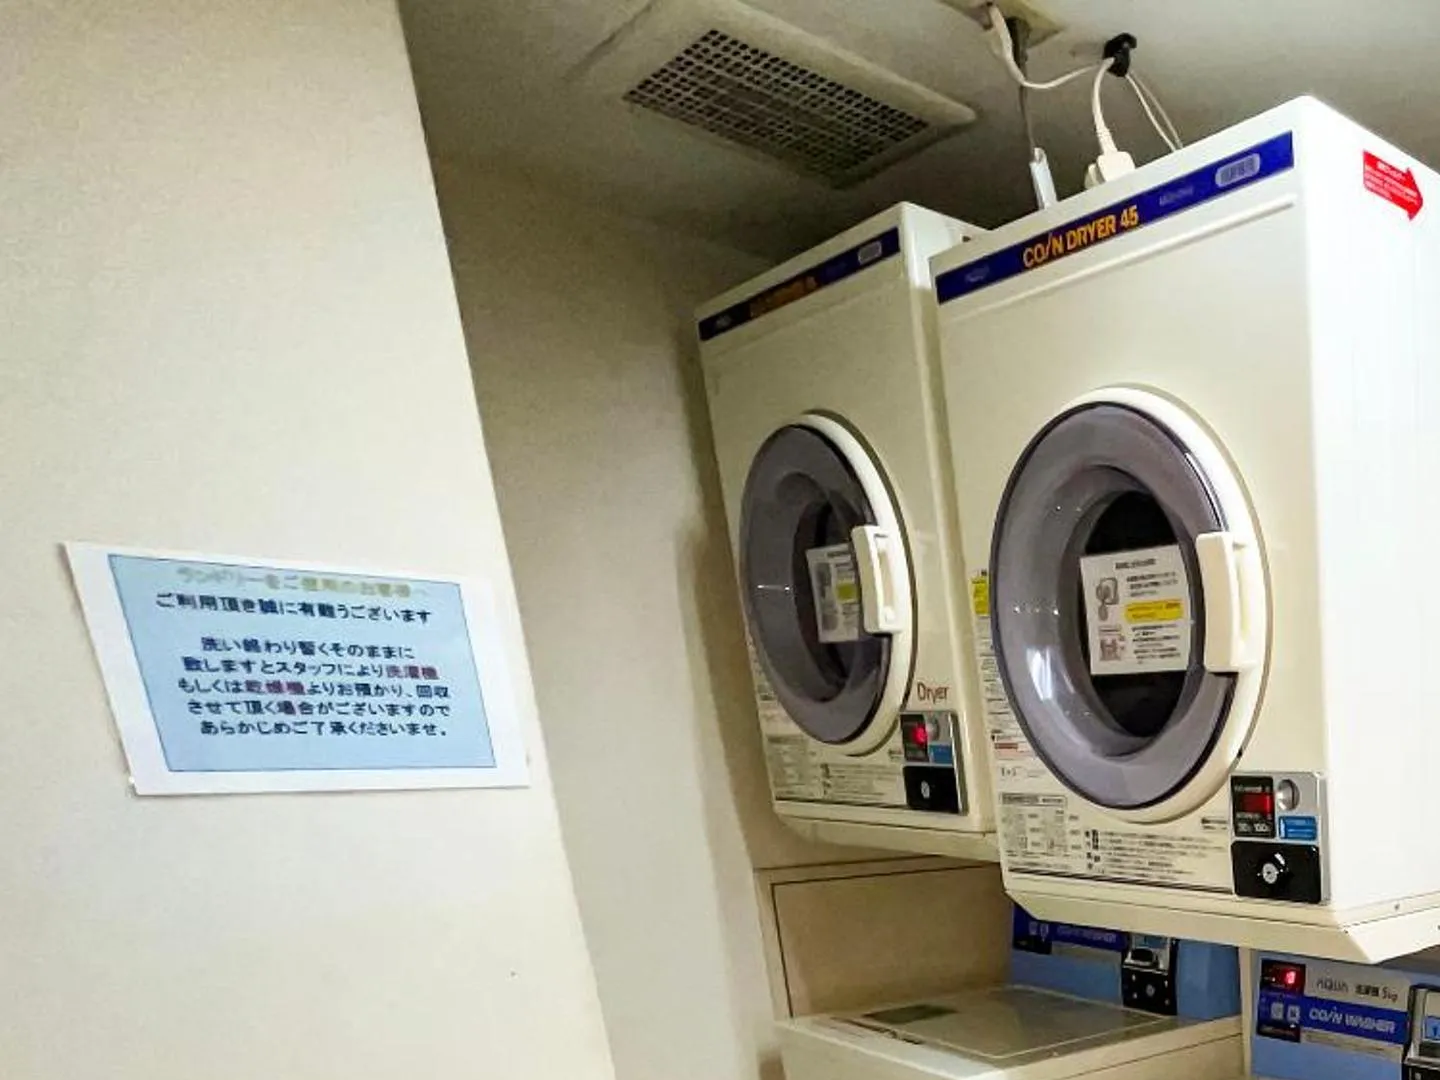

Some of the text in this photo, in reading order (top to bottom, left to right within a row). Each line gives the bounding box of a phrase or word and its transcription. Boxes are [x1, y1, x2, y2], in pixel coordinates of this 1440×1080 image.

[1066, 215, 1117, 250] DRYER
[1119, 204, 1140, 231] 45
[156, 592, 431, 624] ご利用頂き誠に有難うございます
[917, 682, 949, 703] Dryer
[187, 699, 450, 717] させて頂く場合がございますので
[201, 720, 447, 737] あらかじめご了承くださいませ。
[1316, 979, 1349, 993] AQUA
[1345, 1013, 1395, 1034] WASHER
